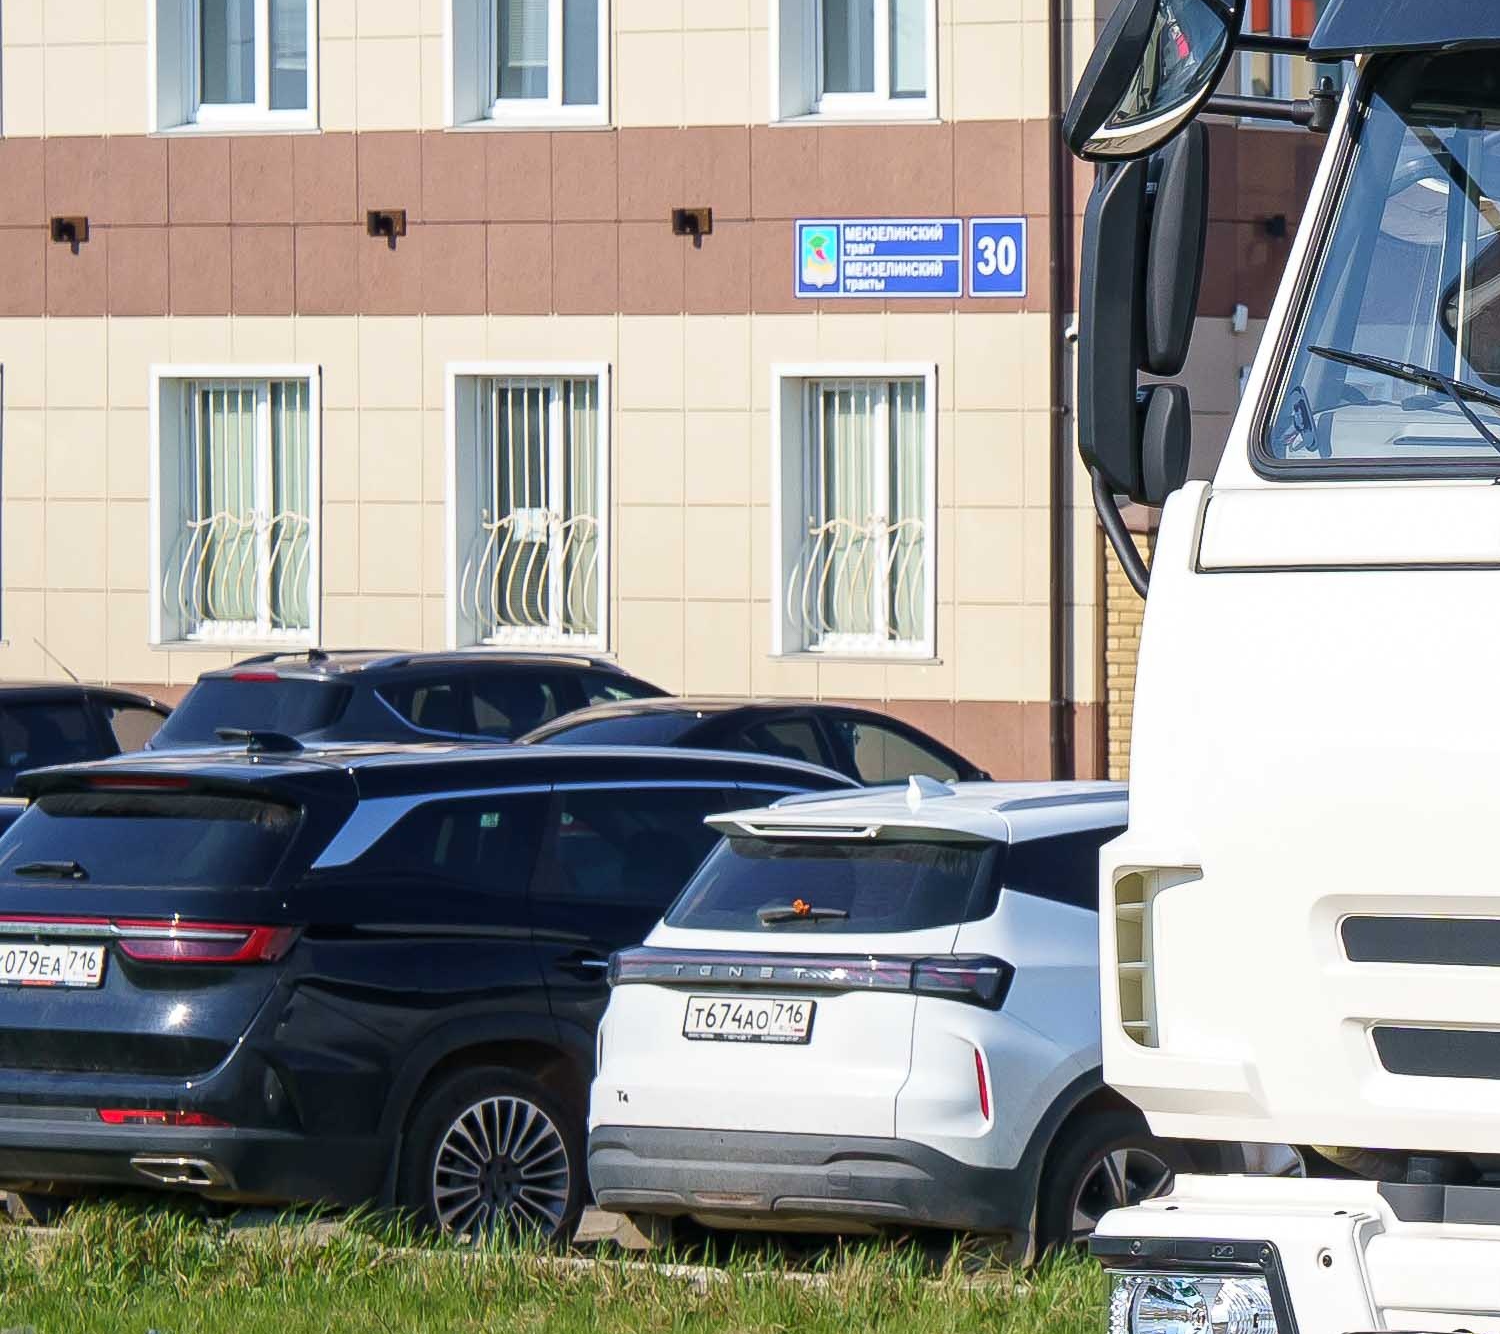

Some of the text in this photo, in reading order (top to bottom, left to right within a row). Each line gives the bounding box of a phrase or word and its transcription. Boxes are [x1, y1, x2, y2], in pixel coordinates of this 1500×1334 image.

[844, 224, 943, 242] МЕНЗЕЛИНСКИЙ
[845, 243, 875, 255] тракт
[976, 235, 1017, 276] 30
[844, 259, 943, 277] МЕНЗЕЛИНСКИЙ
[845, 279, 885, 292] тракты
[0, 950, 96, 975] 079EA 716
[694, 1003, 803, 1030] T674AO 716
